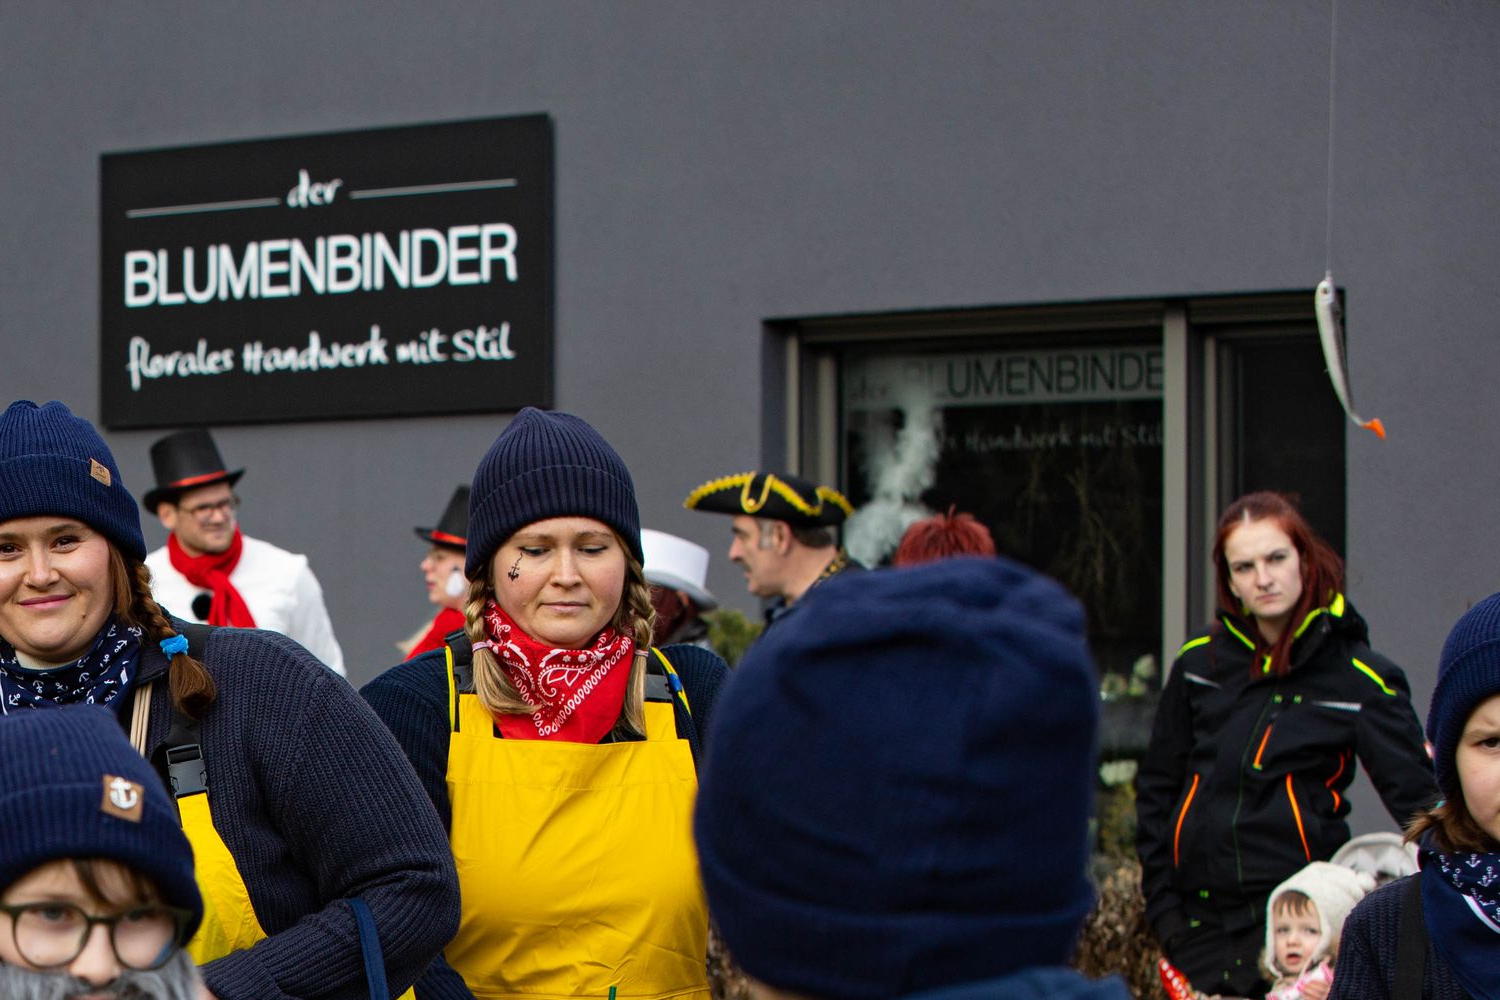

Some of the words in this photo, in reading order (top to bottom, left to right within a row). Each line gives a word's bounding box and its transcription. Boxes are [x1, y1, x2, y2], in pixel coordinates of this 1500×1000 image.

[287, 169, 342, 208] der
[124, 223, 518, 307] BLUMENBINDER
[127, 335, 233, 391] florales
[242, 324, 389, 375] Handwerk
[395, 327, 448, 364] mit
[452, 321, 516, 361] Stil
